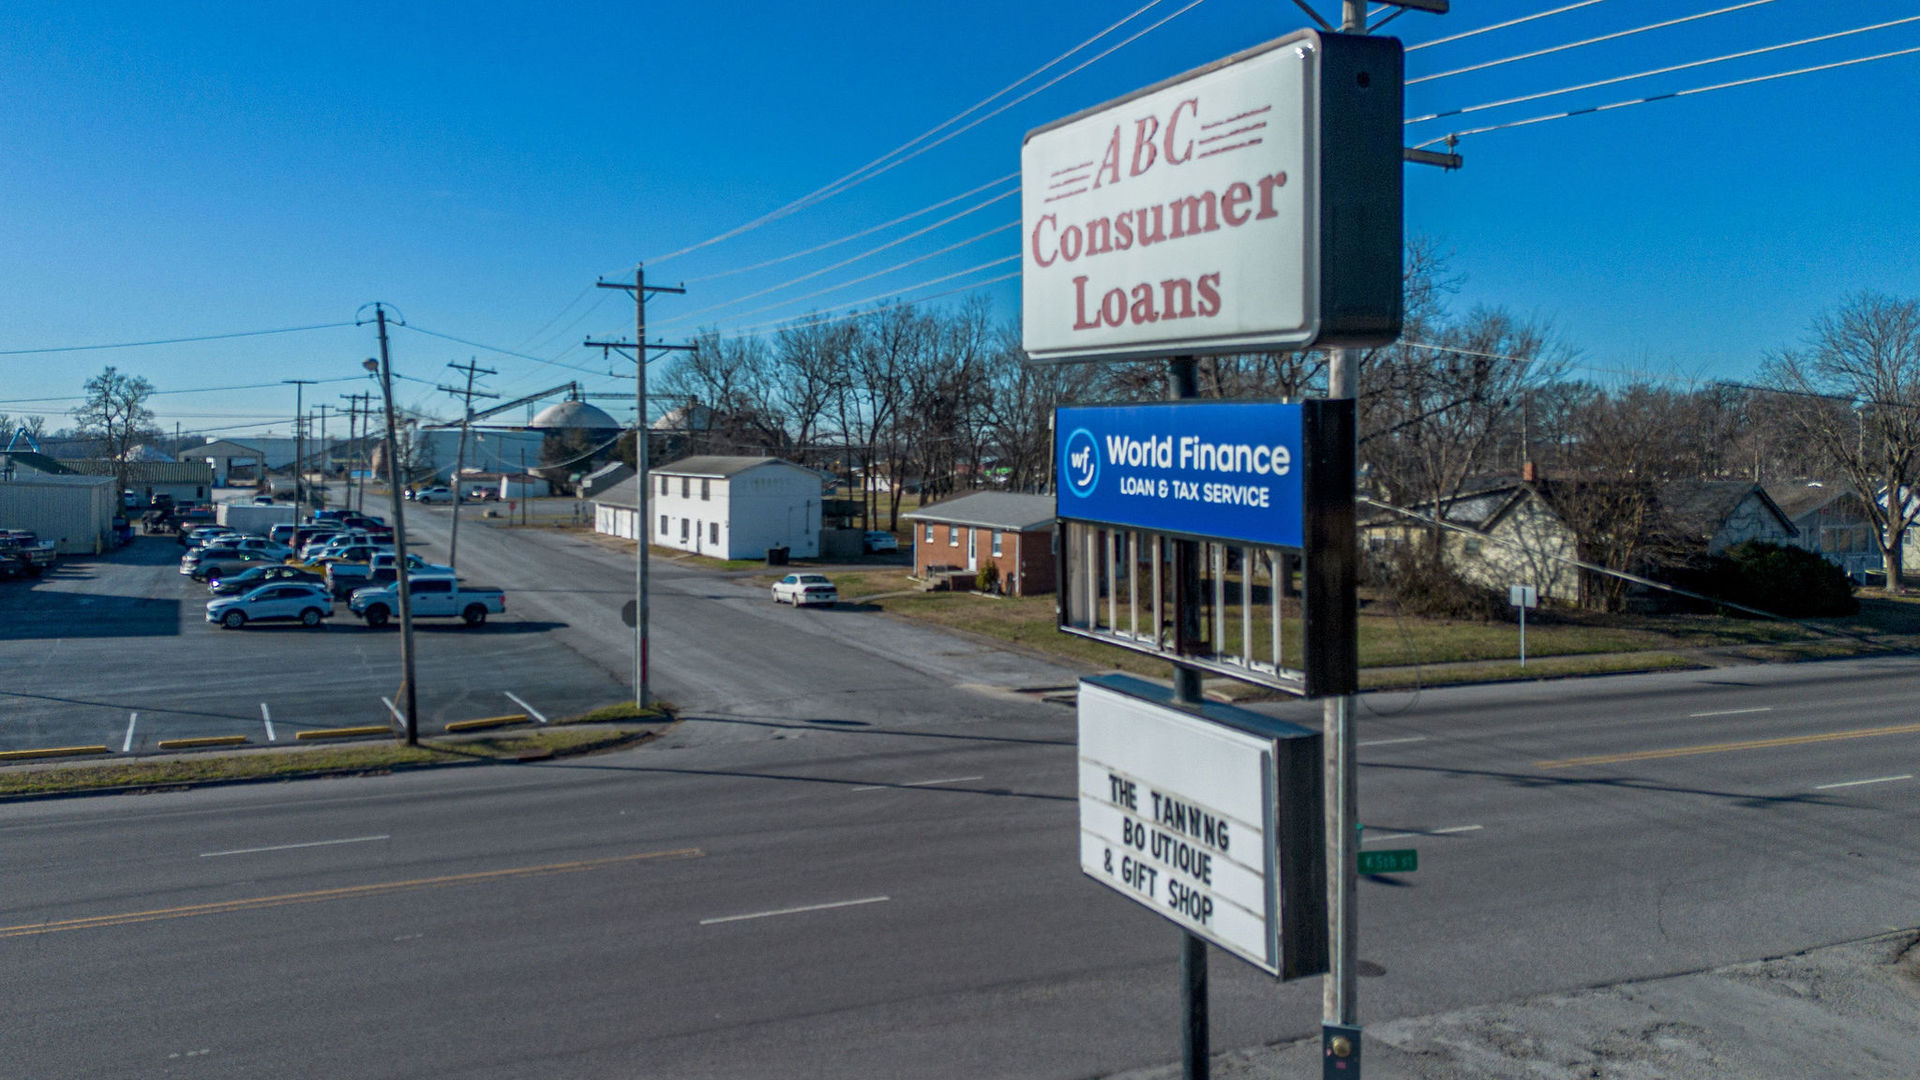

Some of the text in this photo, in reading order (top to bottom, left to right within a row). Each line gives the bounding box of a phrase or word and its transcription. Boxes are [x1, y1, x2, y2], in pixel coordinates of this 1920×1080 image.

[1093, 98, 1199, 190] ABC
[1031, 171, 1288, 268] Consumer
[1072, 271, 1221, 331] Loans
[1106, 435, 1291, 476] World Finance
[1120, 476, 1270, 508] LOAN & TAX SERVICE
[1109, 773, 1138, 812] THE
[1103, 847, 1214, 926] & GIFT SHOP
